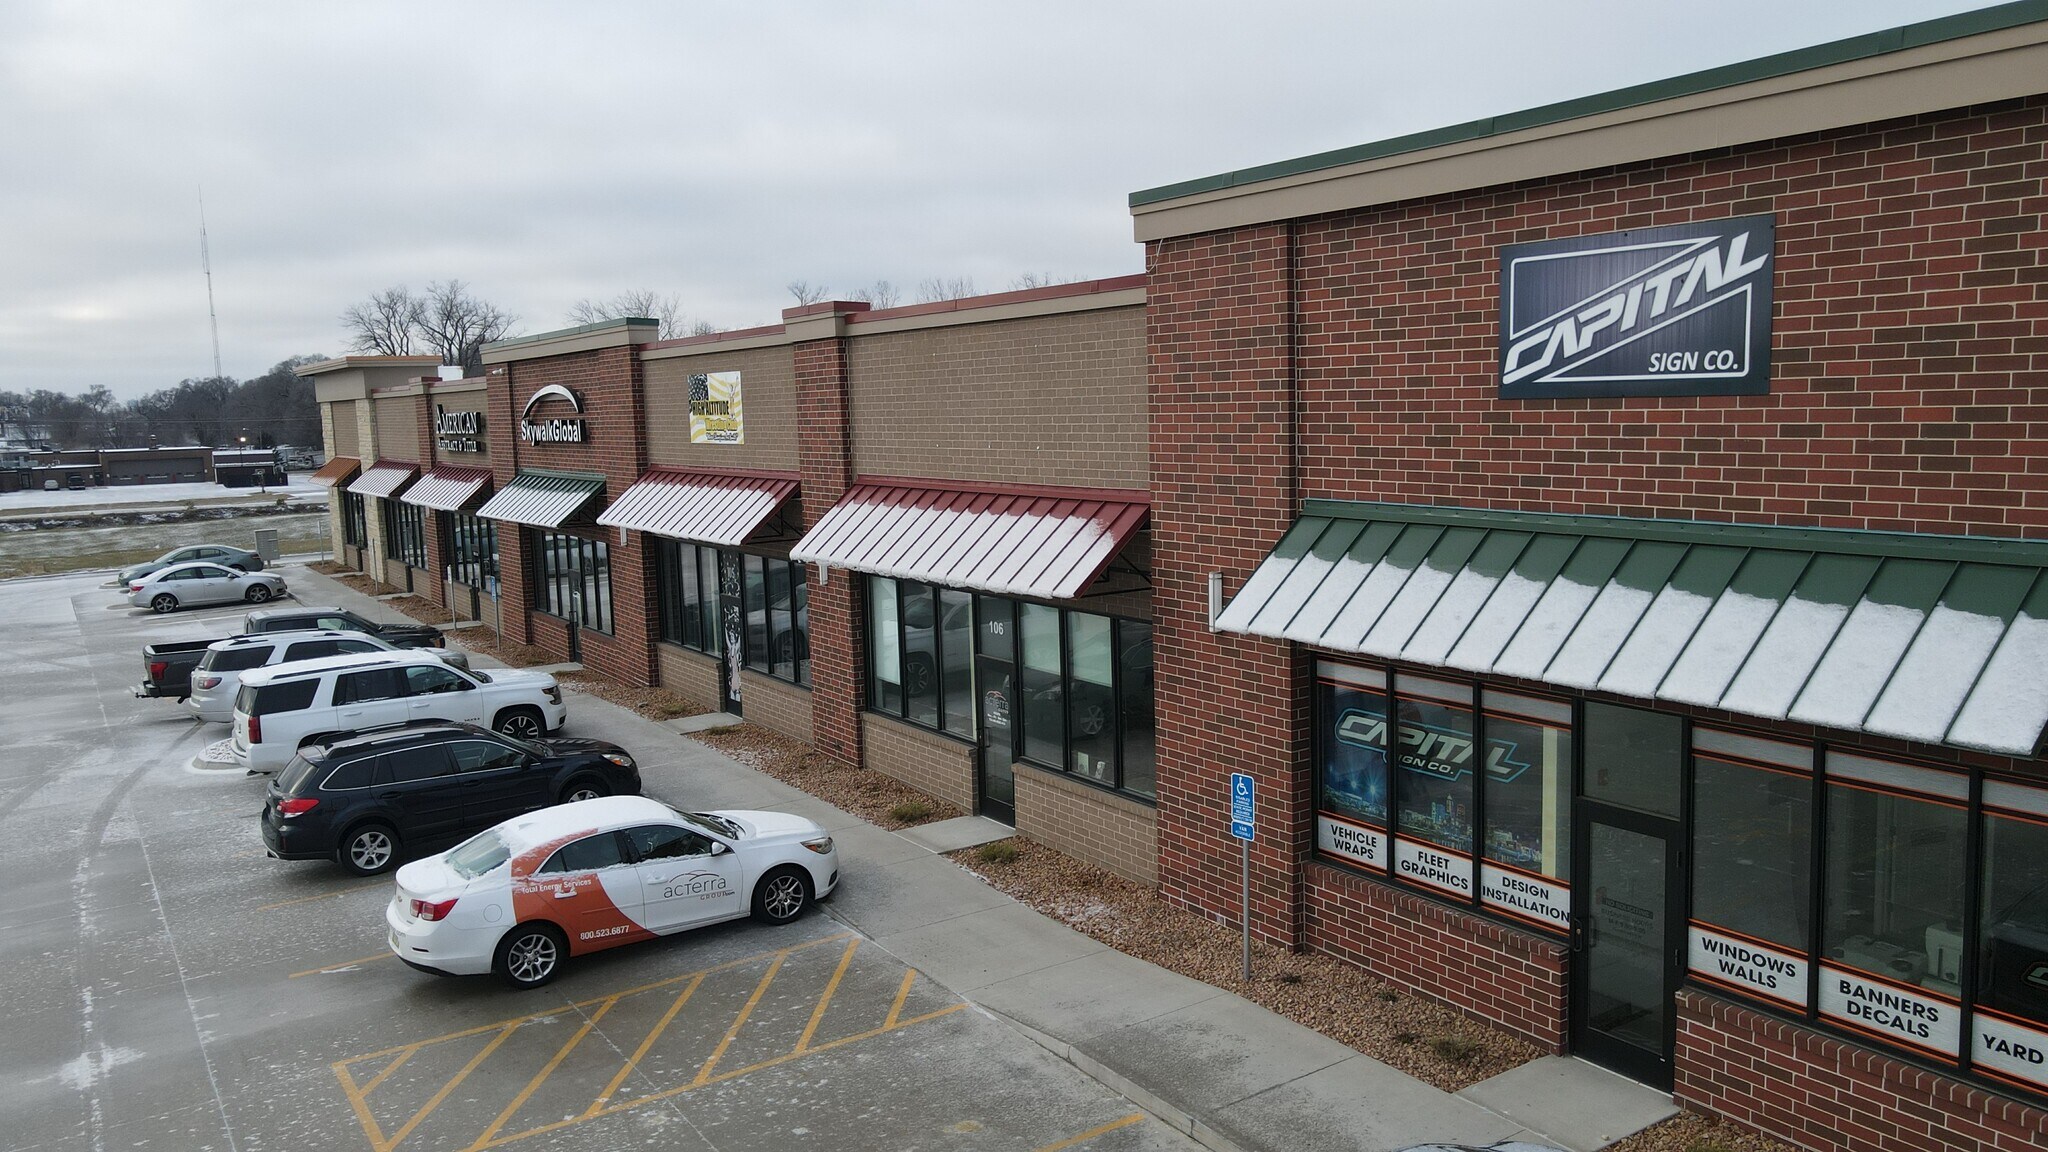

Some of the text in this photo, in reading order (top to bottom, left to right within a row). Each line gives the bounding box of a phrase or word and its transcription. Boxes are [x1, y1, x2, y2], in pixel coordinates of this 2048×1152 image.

[1502, 231, 1769, 385] CAPITAL
[1649, 349, 1738, 373] SIGN CO.
[436, 403, 478, 434] AMERICAN
[706, 400, 730, 416] ALTITUDE
[521, 419, 582, 447] SkywalkGlobal
[989, 620, 1004, 636] 106
[1427, 761, 1455, 775] CO.
[1330, 824, 1377, 848] VEHICLE
[1333, 837, 1375, 860] WRAPS
[1417, 850, 1450, 870] FLEET
[522, 879, 592, 894] Total Energy Services
[1401, 860, 1469, 891] GRAPHICS
[1502, 876, 1550, 900] DESIGN
[1482, 886, 1570, 922] INSTALLATION
[580, 924, 629, 940] 800.523.6877
[1702, 937, 1797, 977] WINDOWS
[1718, 959, 1777, 989] WALLS
[1839, 979, 1939, 1022] BANNERS
[1846, 1000, 1930, 1039] DECALS
[1983, 1033, 2044, 1065] YARD
